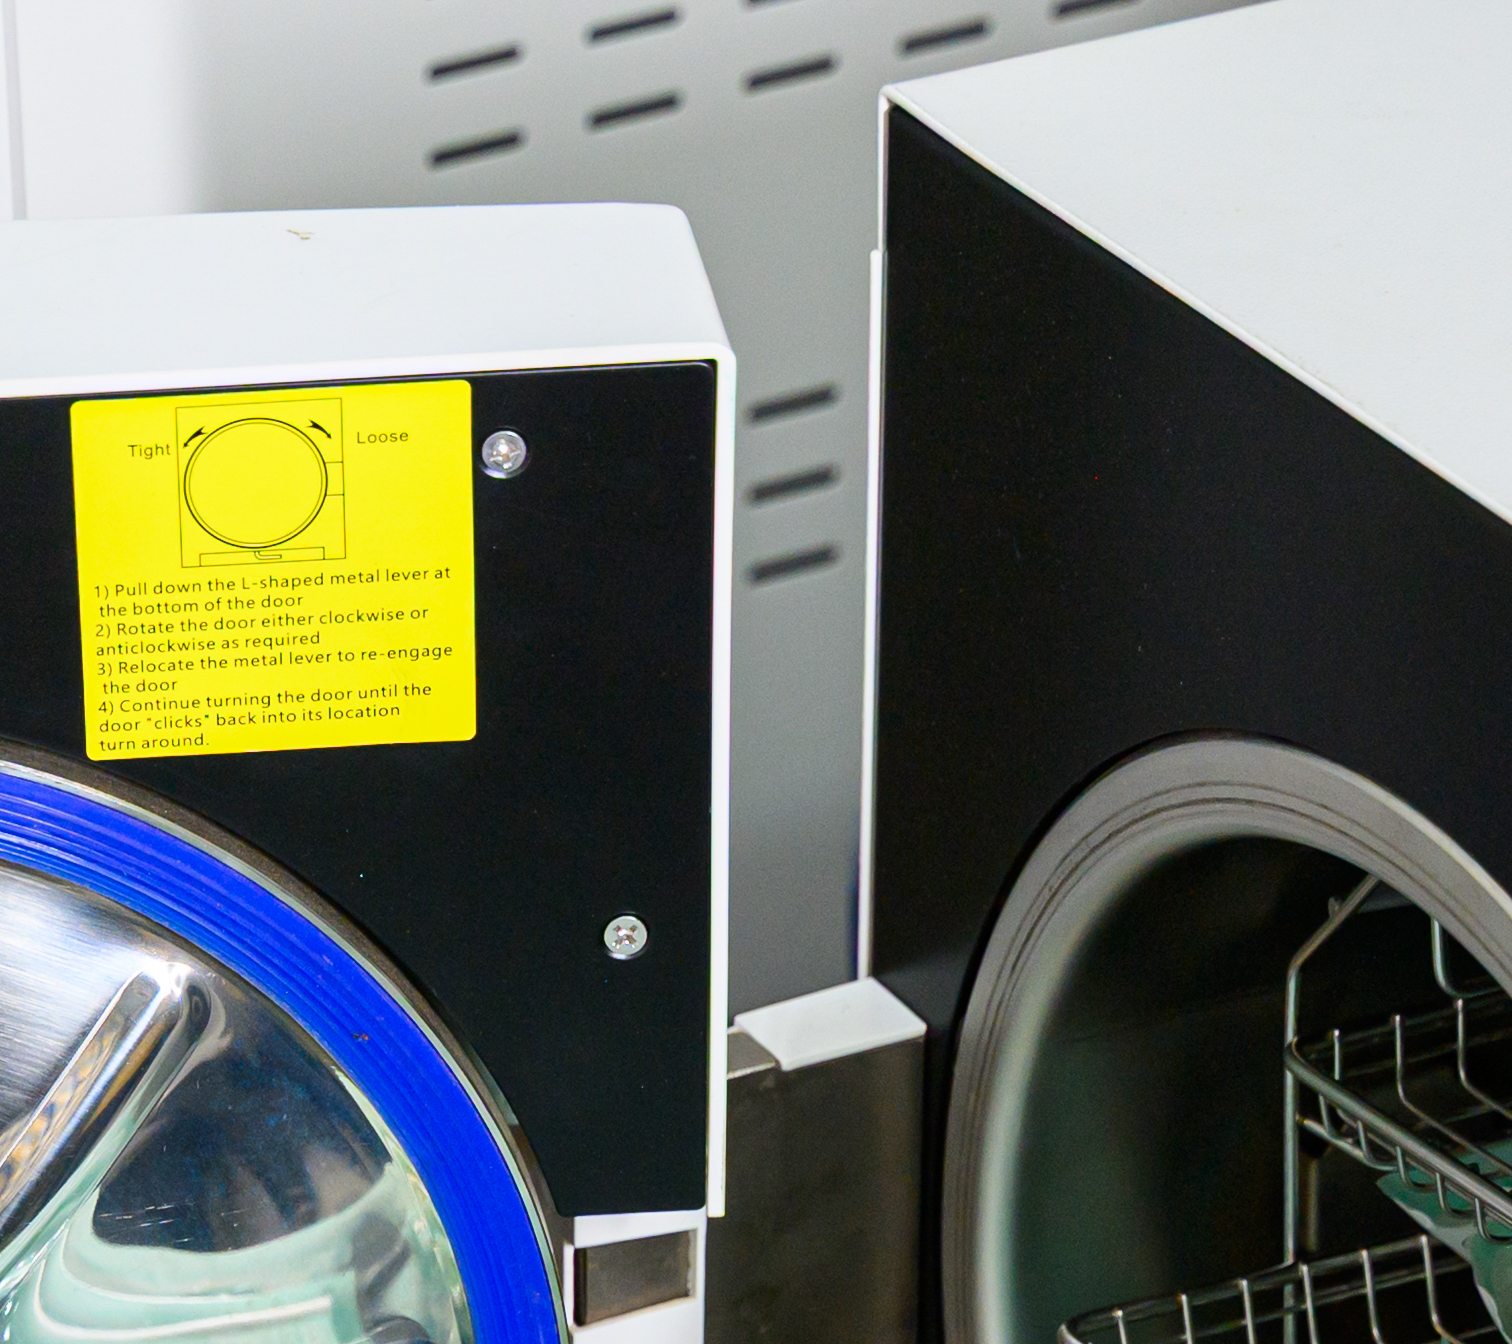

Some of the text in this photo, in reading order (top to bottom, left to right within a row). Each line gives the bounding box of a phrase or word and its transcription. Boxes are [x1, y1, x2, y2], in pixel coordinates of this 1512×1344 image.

[357, 432, 409, 444] Loose
[127, 444, 170, 460] Tight
[94, 567, 450, 600] 1) Pull down the L-shaped metal lever at
[99, 594, 303, 618] the bottom of the door
[96, 608, 429, 639] 2) Rotate the door either clockwise or
[96, 631, 320, 656] anticlockwise as required
[98, 646, 452, 677] 3) Relocate the metal lever to re-engage
[98, 683, 432, 715] 4) Continue turning the door until the
[103, 679, 177, 695] the door
[99, 719, 140, 733] door
[216, 712, 256, 726] back
[262, 711, 297, 723] into
[302, 708, 322, 721] its
[328, 704, 400, 720] location
[99, 733, 209, 752] turn around.
